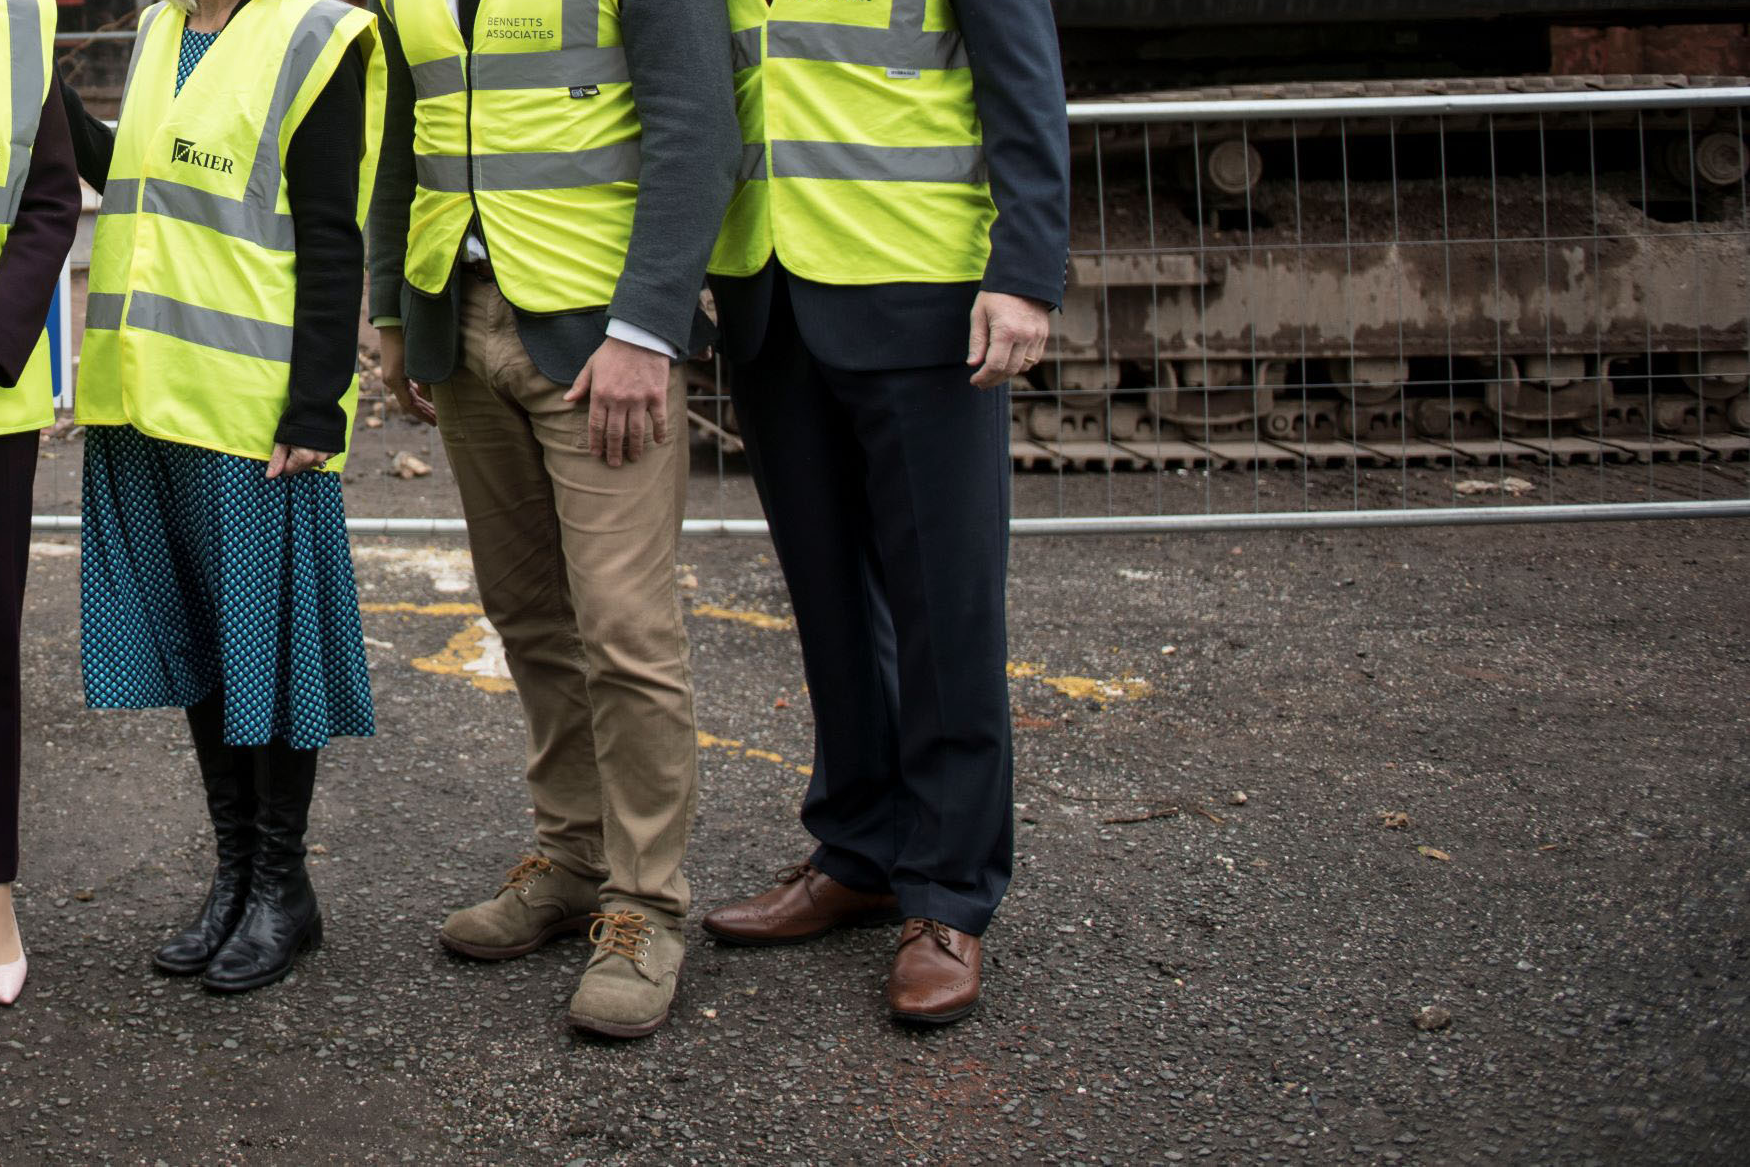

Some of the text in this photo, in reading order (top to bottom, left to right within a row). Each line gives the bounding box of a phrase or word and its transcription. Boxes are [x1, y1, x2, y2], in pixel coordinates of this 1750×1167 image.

[487, 17, 543, 27] BENNETTS
[486, 29, 554, 40] ASSOCIATES
[191, 149, 234, 174] KIER
